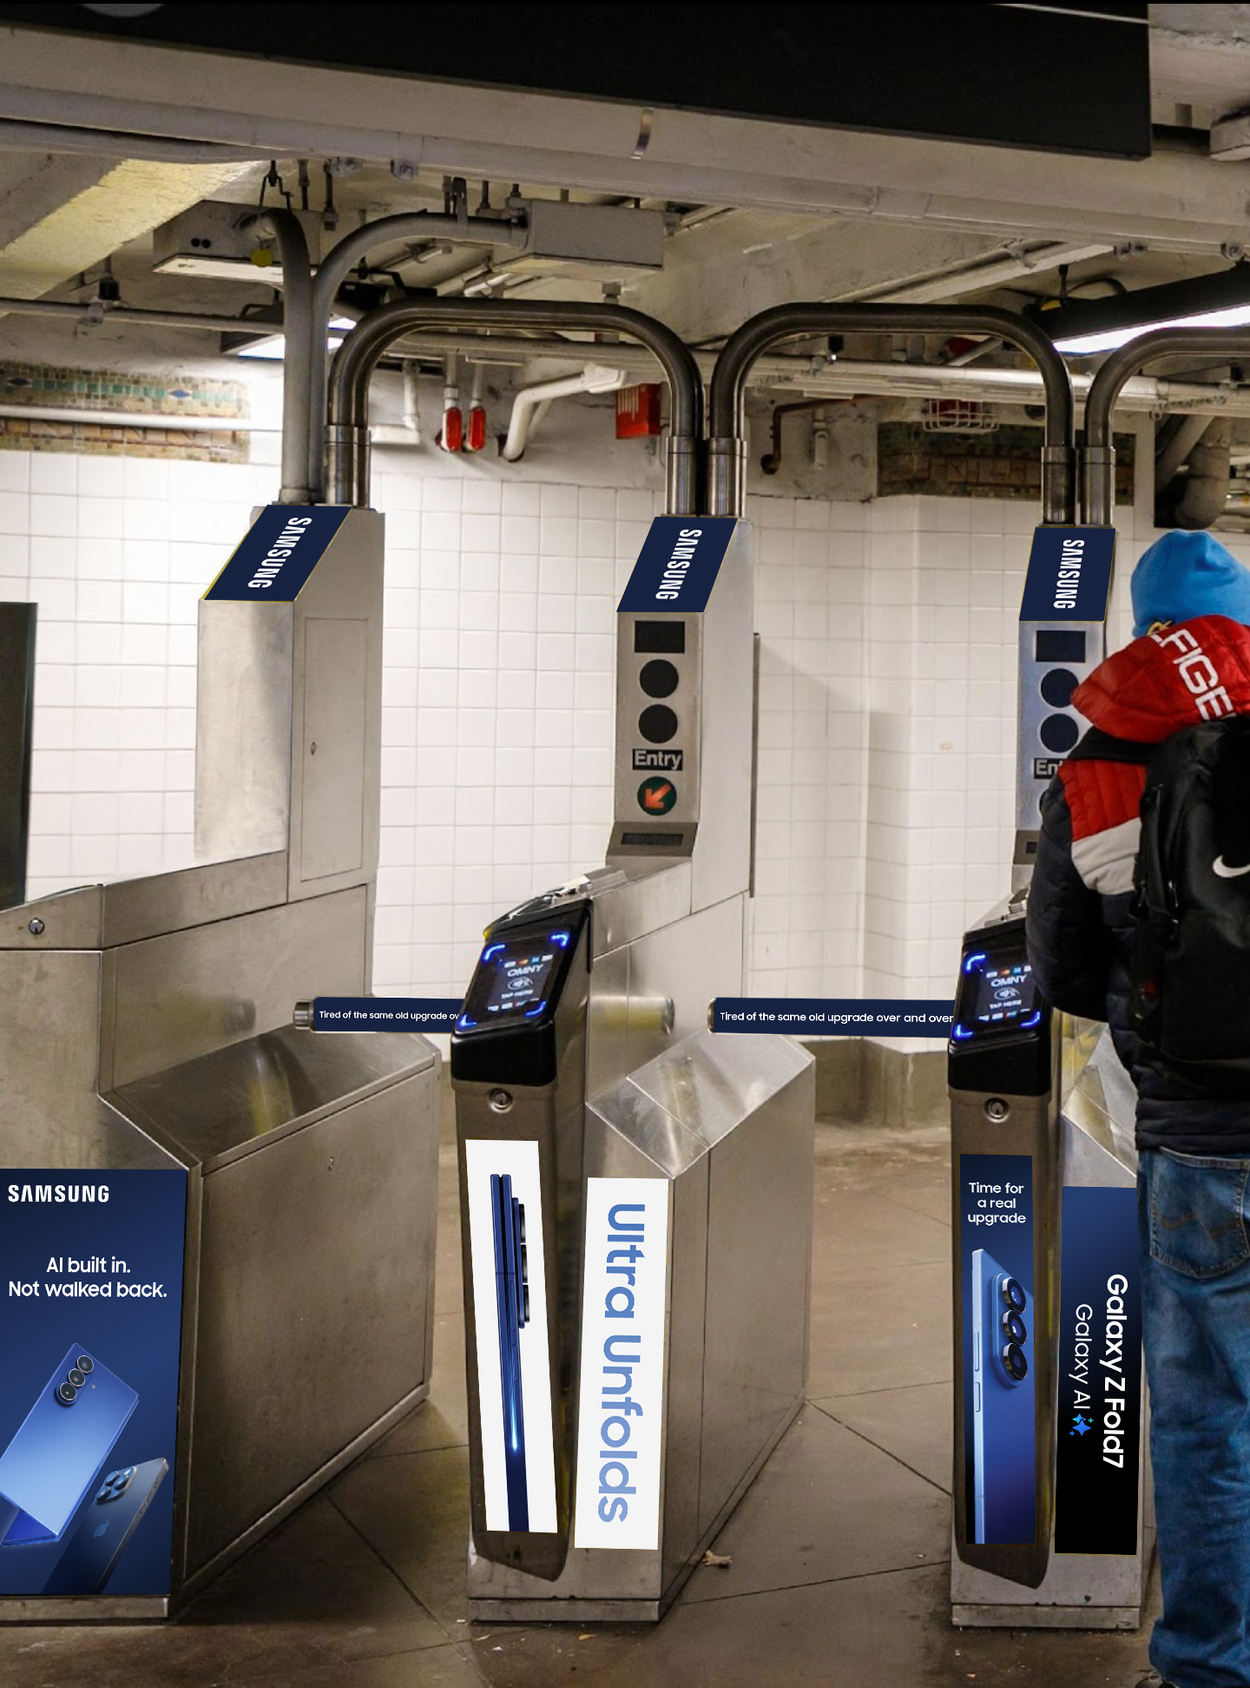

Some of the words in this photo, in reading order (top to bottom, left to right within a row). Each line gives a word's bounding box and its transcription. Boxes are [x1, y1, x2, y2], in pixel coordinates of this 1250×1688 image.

[247, 517, 312, 588] SAMSUNG
[655, 528, 703, 600] SAMSUNG
[1053, 539, 1085, 609] SAMSUNG
[1150, 629, 1236, 720] FIGE
[634, 750, 682, 771] Entry
[507, 963, 544, 977] OMNY
[991, 975, 1027, 987] OMNY
[319, 1010, 341, 1019] Tired
[342, 1010, 352, 1019] of
[353, 1011, 368, 1019] the
[395, 1011, 409, 1020] old
[410, 1012, 448, 1022] upgrade
[720, 1012, 745, 1021] Tired
[746, 1012, 757, 1021] of
[758, 1012, 776, 1021] the
[777, 1014, 807, 1022] same
[809, 1013, 825, 1022] old
[827, 1013, 874, 1024] upgrade
[903, 1013, 926, 1023] and
[7, 1184, 110, 1203] SAMSUNG
[968, 1181, 1002, 1194] Time
[1004, 1182, 1025, 1194] for
[977, 1199, 987, 1208] a
[989, 1197, 1017, 1209] real
[967, 1212, 1027, 1226] upgrade
[46, 1256, 64, 1273] AI
[67, 1255, 107, 1273] built
[111, 1255, 131, 1273] in.
[604, 1203, 646, 1319] Ultra
[8, 1280, 40, 1297] Not
[44, 1281, 112, 1297] walked
[116, 1281, 168, 1298] back.
[1099, 1273, 1129, 1373] Galaxy
[1068, 1303, 1093, 1385] Galaxy
[1104, 1376, 1126, 1392] Z
[1073, 1389, 1091, 1409] AI
[597, 1334, 644, 1523] Unfolds
[1102, 1398, 1126, 1469] Fold7
